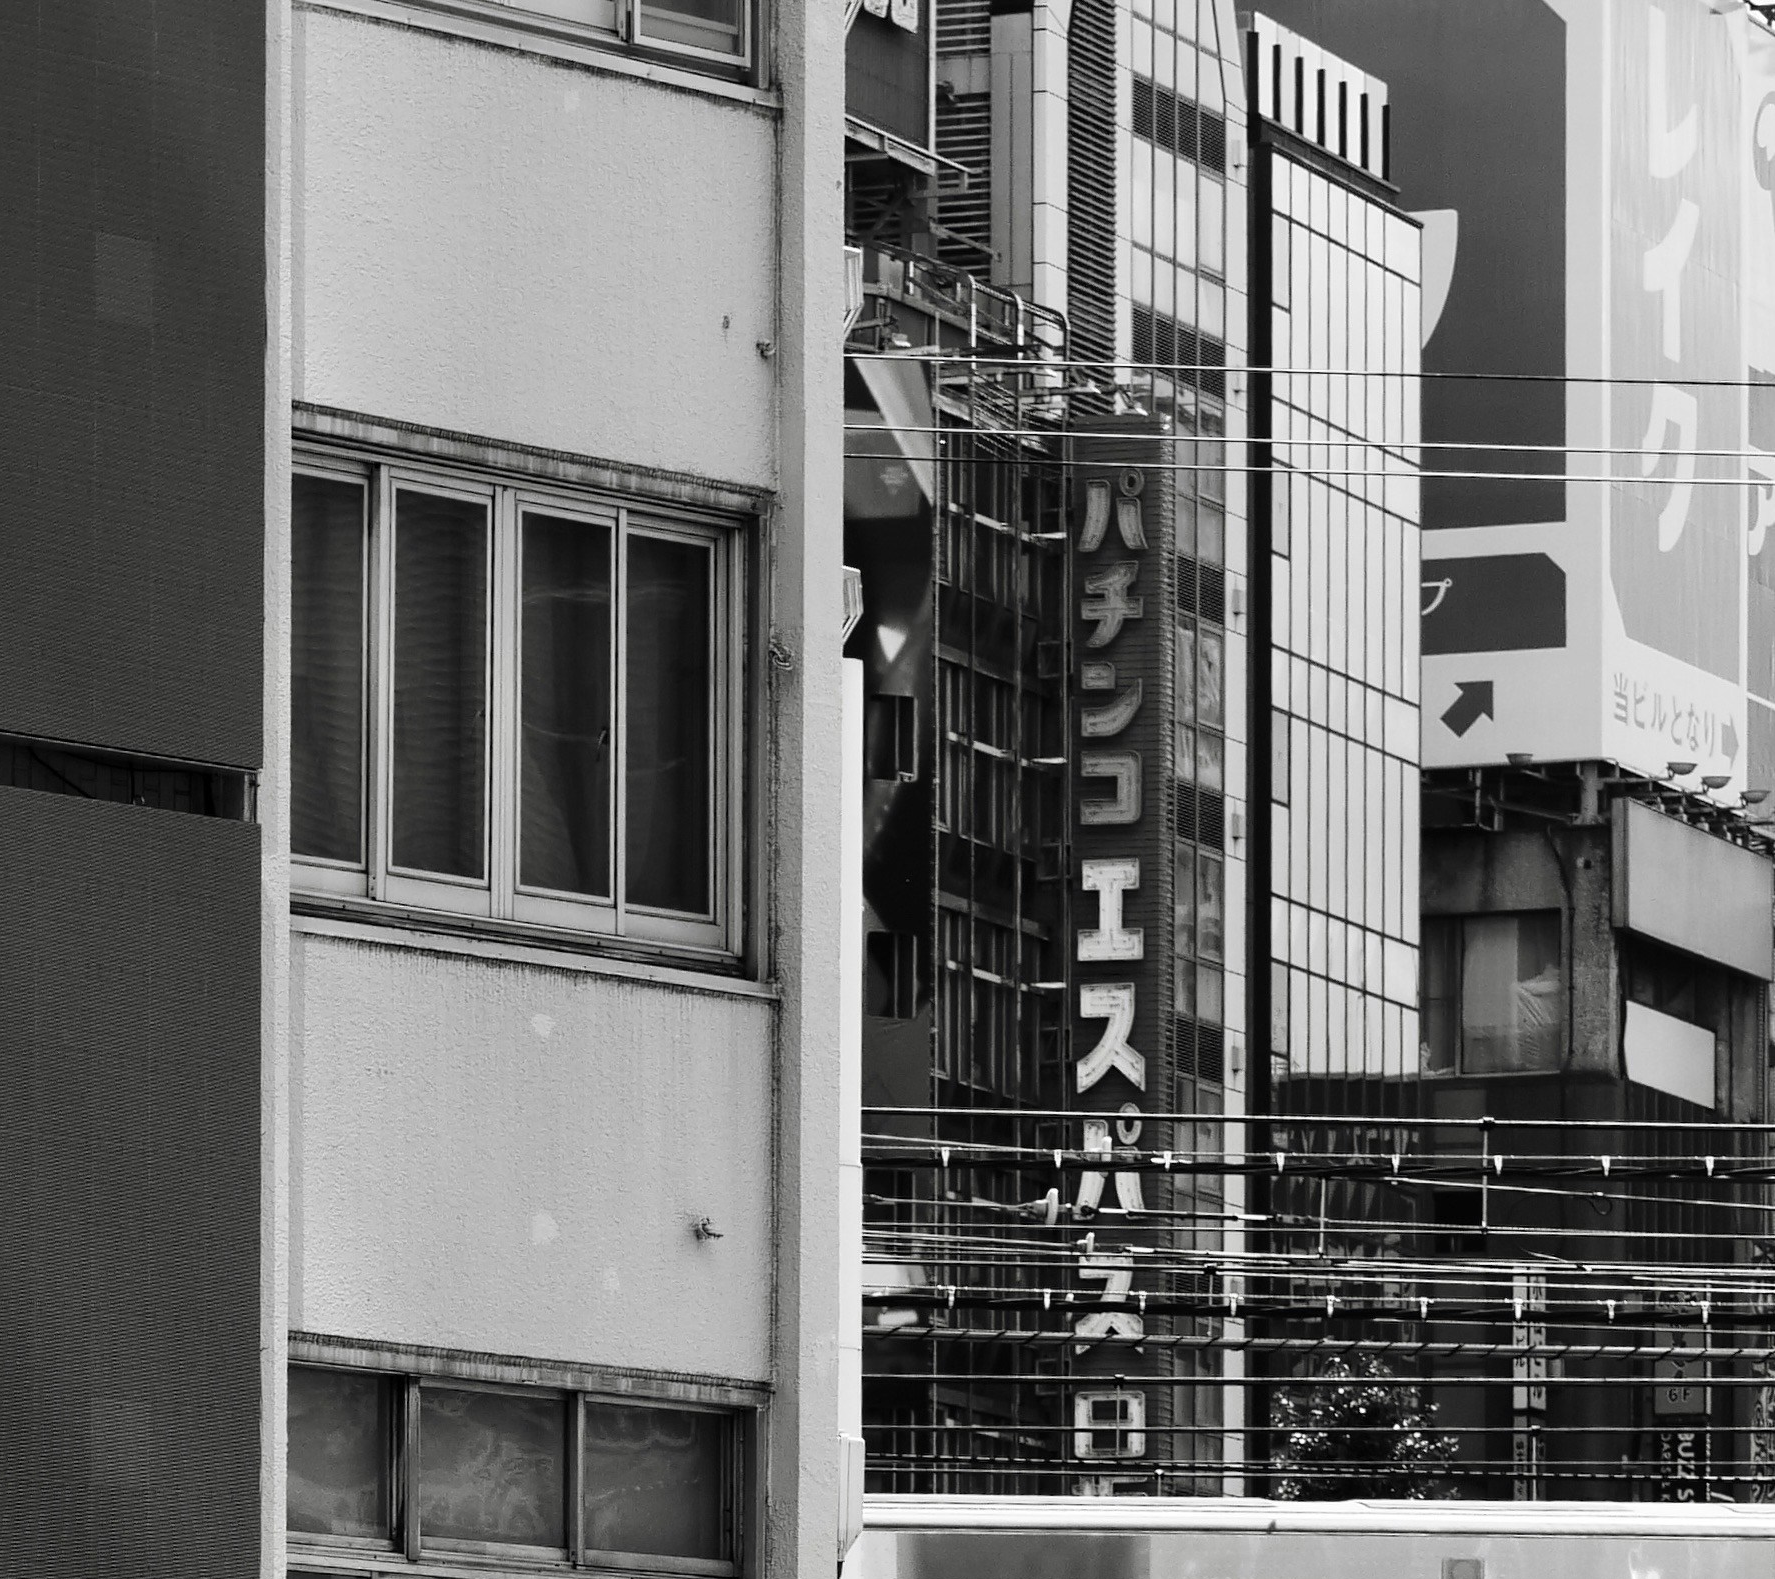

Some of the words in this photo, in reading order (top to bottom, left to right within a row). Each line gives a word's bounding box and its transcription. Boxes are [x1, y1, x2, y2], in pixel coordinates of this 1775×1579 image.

[1642, 3, 1699, 553] レイク
[1613, 672, 1715, 757] 当ビルとなり
